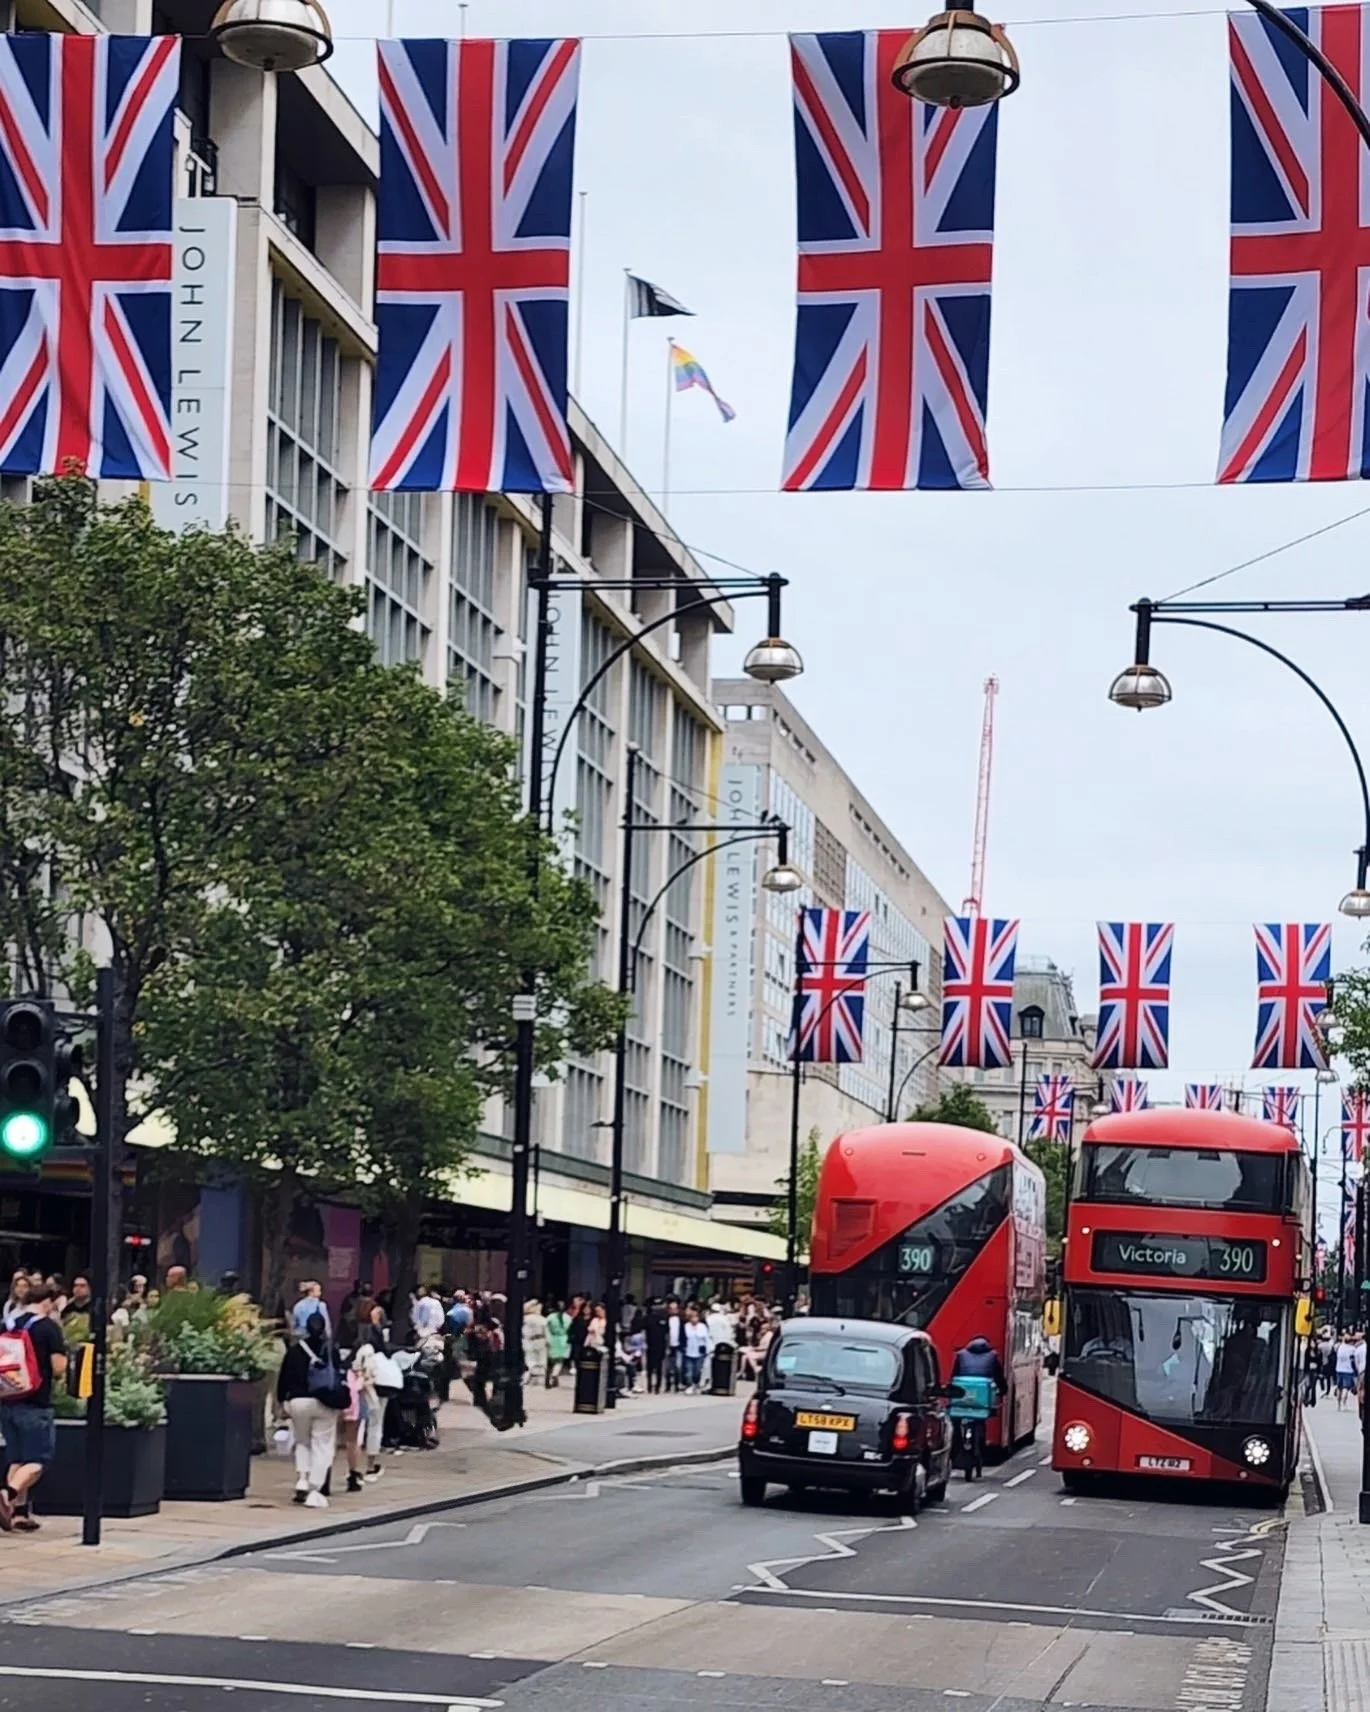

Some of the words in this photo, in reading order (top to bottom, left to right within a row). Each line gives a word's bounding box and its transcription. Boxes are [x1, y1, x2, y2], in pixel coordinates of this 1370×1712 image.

[179, 225, 206, 343] JOHN
[174, 369, 202, 506] LEWIS
[726, 852, 741, 923] LEWIS
[901, 1248, 932, 1271] 390
[1118, 1243, 1186, 1265] Victoria
[1219, 1247, 1254, 1273] 390
